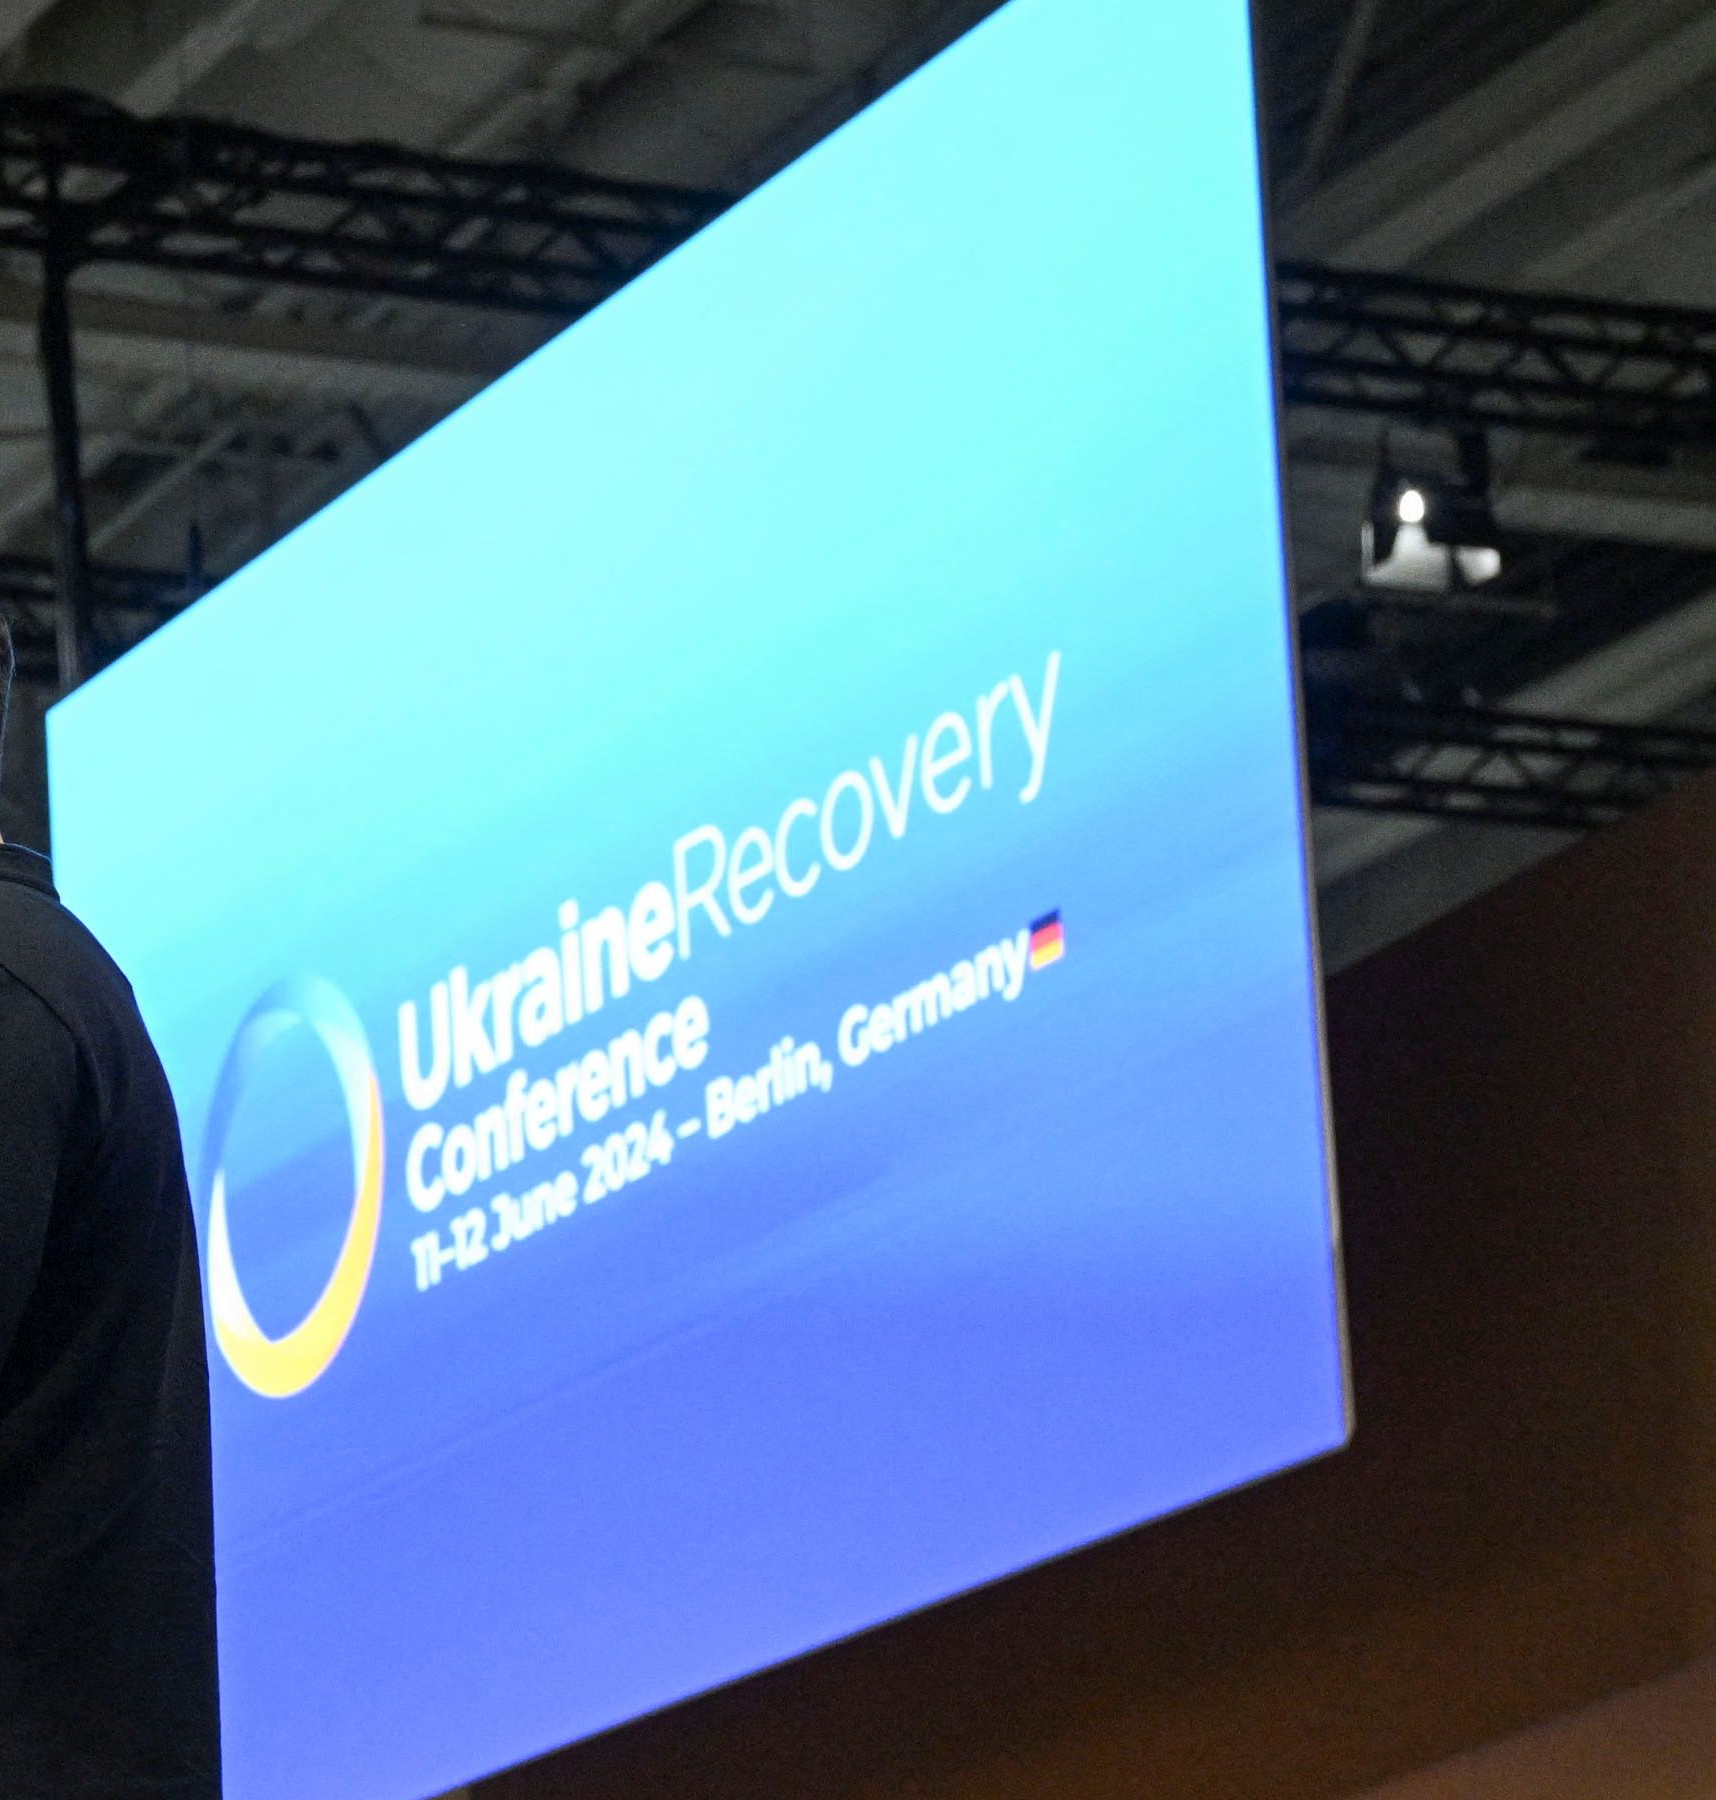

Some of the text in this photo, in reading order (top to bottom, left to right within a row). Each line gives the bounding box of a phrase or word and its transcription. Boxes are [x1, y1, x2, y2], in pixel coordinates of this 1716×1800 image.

[405, 994, 711, 1213] Conference
[490, 1171, 579, 1252] June
[581, 1110, 675, 1204] 2024
[705, 1036, 834, 1140] Berlin,
[837, 928, 1031, 1067] Germany
